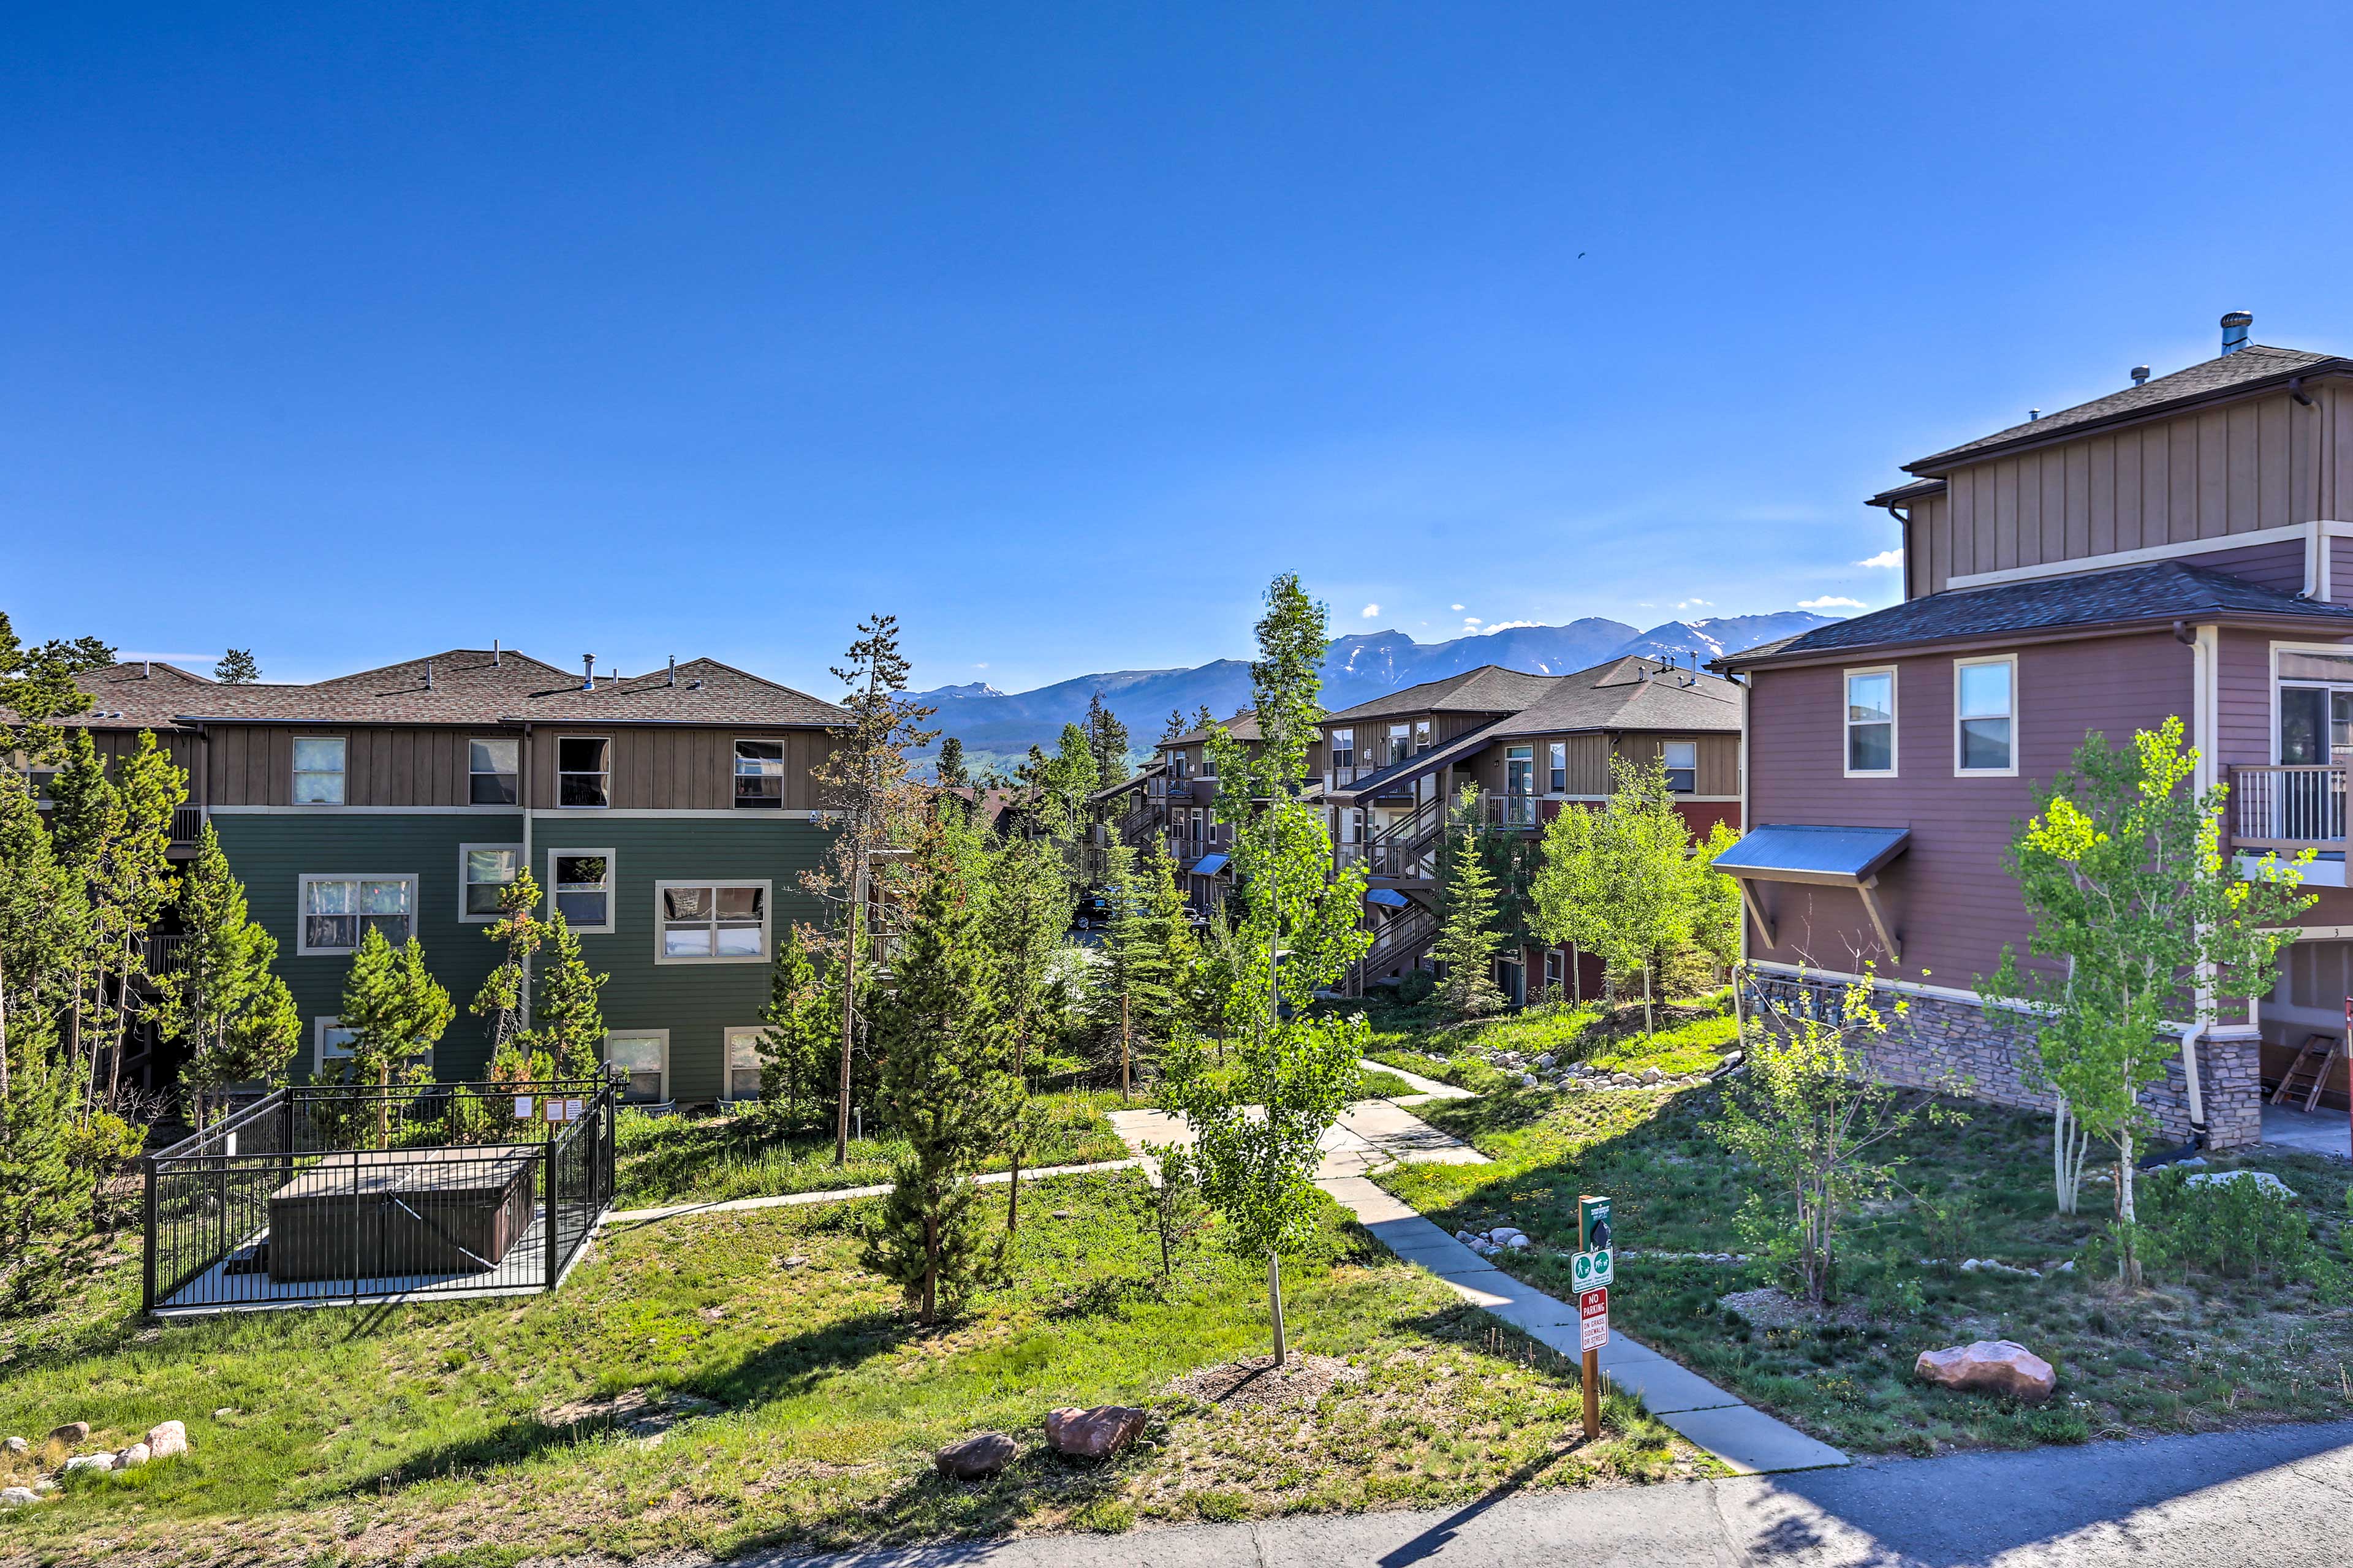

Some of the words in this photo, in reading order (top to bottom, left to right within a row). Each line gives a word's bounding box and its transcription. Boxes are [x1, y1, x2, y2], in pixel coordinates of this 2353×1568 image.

[2335, 928, 2338, 937] 3
[1589, 1294, 1599, 1305] NO
[1583, 1302, 1605, 1317] PARKING
[1591, 1333, 1605, 1343] STREET
